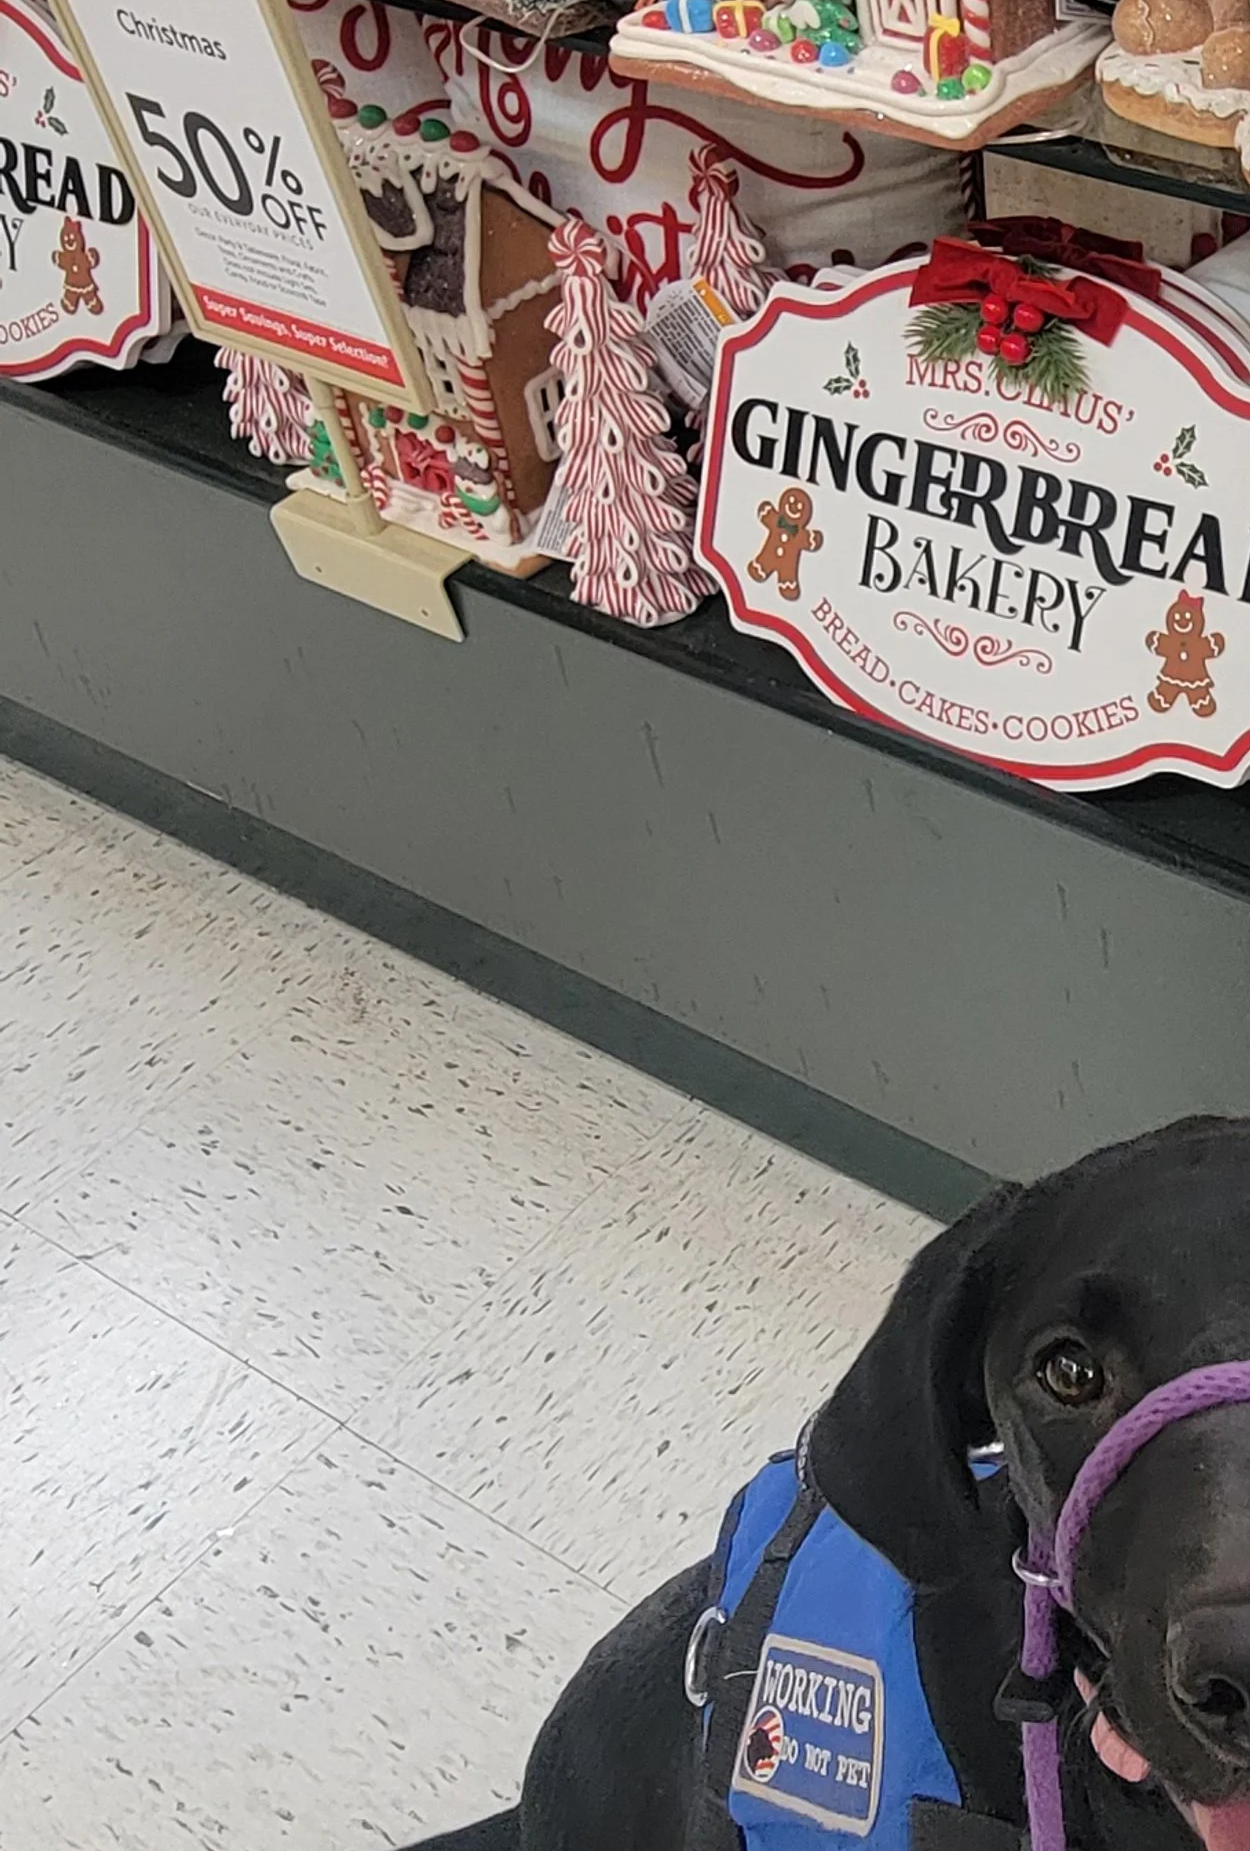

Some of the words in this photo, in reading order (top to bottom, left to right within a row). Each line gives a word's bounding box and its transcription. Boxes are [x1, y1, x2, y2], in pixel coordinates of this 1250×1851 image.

[116, 8, 227, 61] Christmas
[124, 91, 304, 217] 50%
[260, 193, 328, 243] OFF
[203, 294, 238, 318] Super
[291, 323, 327, 348] Super
[906, 353, 990, 397] MRS.
[857, 513, 1108, 654] BAKERY
[810, 597, 890, 688] BREAD
[898, 680, 991, 736] CAKES
[1001, 695, 1141, 743] COOKIES
[762, 1659, 873, 1735] WORKING
[780, 1735, 799, 1766] DO
[804, 1742, 832, 1777] NOT
[835, 1754, 871, 1790] PET
